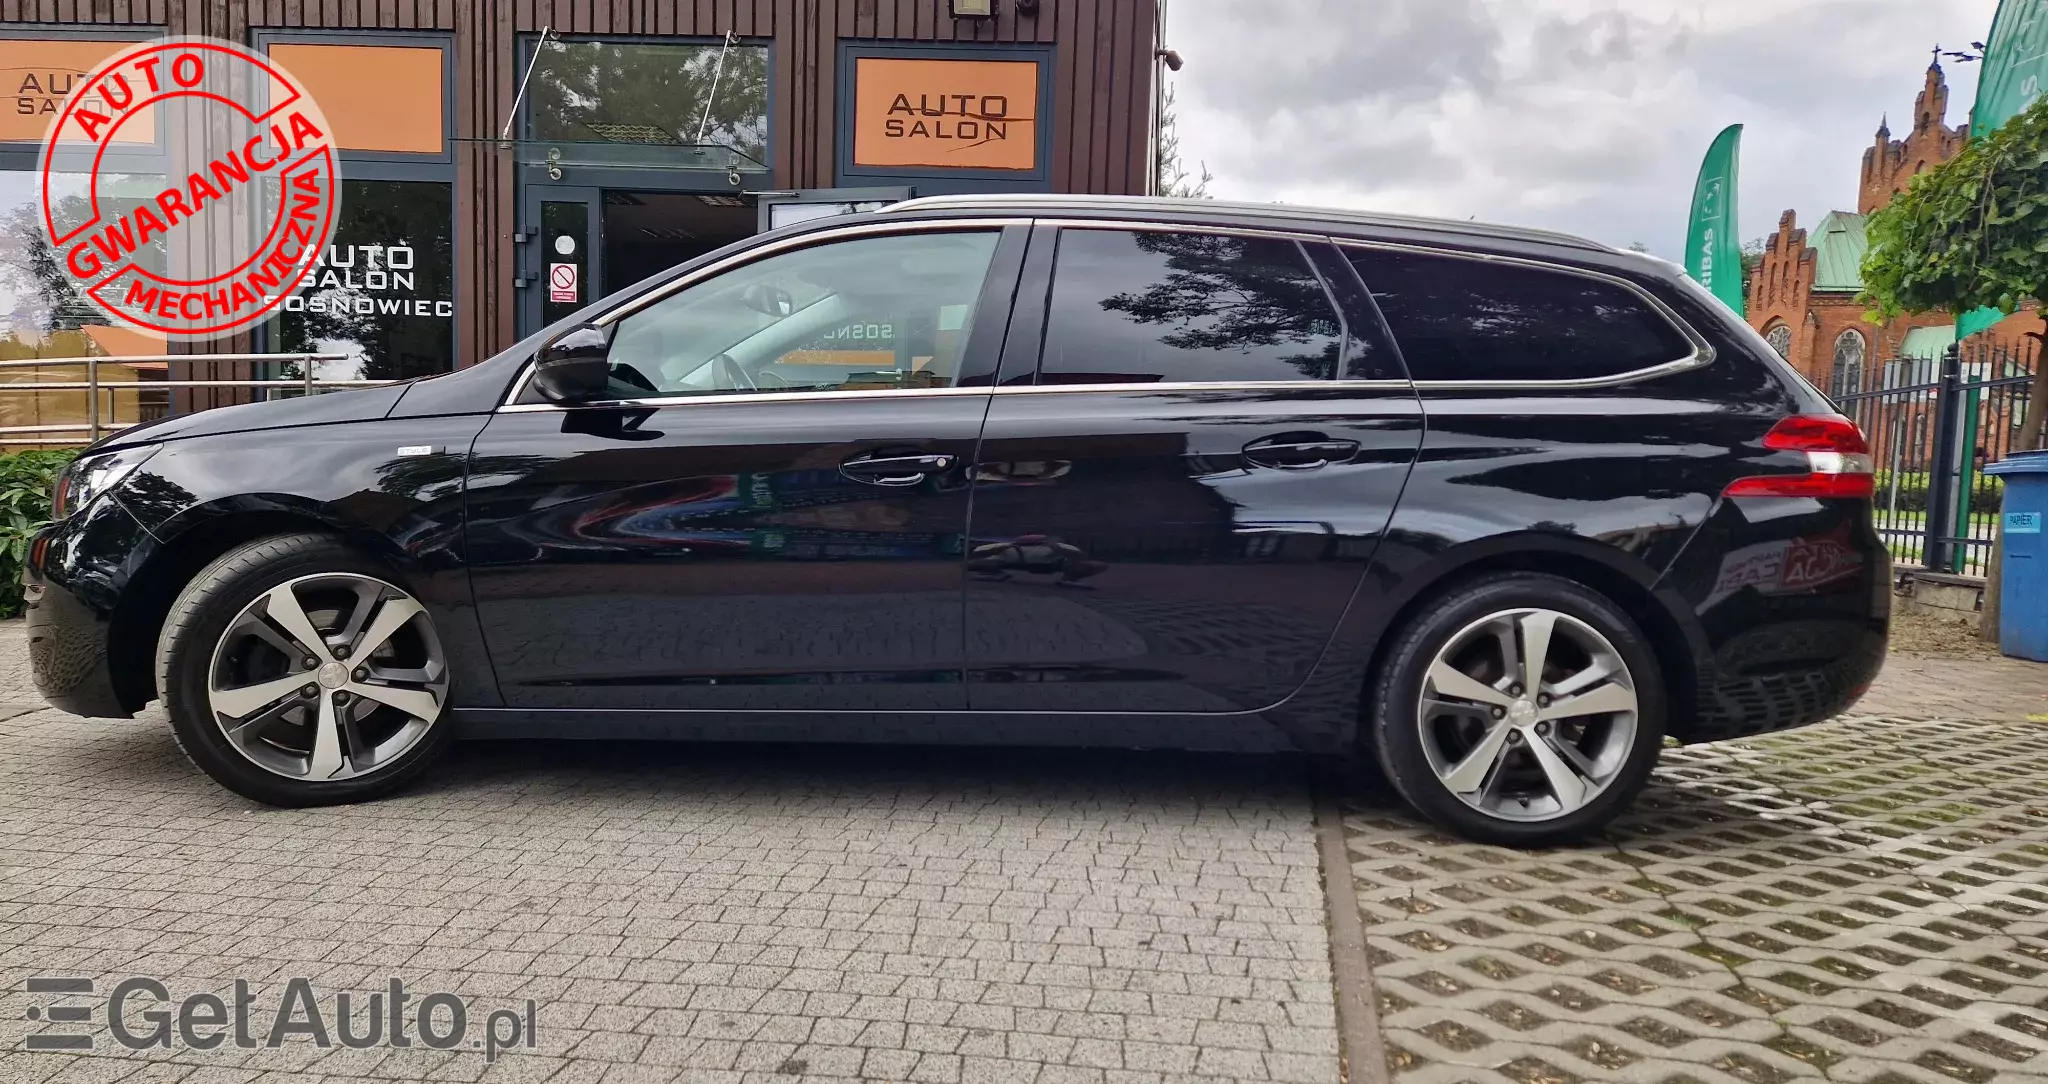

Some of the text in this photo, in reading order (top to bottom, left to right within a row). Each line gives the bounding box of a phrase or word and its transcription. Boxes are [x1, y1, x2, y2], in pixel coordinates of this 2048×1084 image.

[18, 73, 128, 95] AUTO
[887, 93, 1007, 118] AUTO
[885, 119, 1006, 140] SALON
[299, 244, 414, 270] AUTO
[297, 268, 415, 291] SALON
[263, 295, 453, 317] SOSNOWIEC
[2009, 514, 2033, 526] PAPIER
